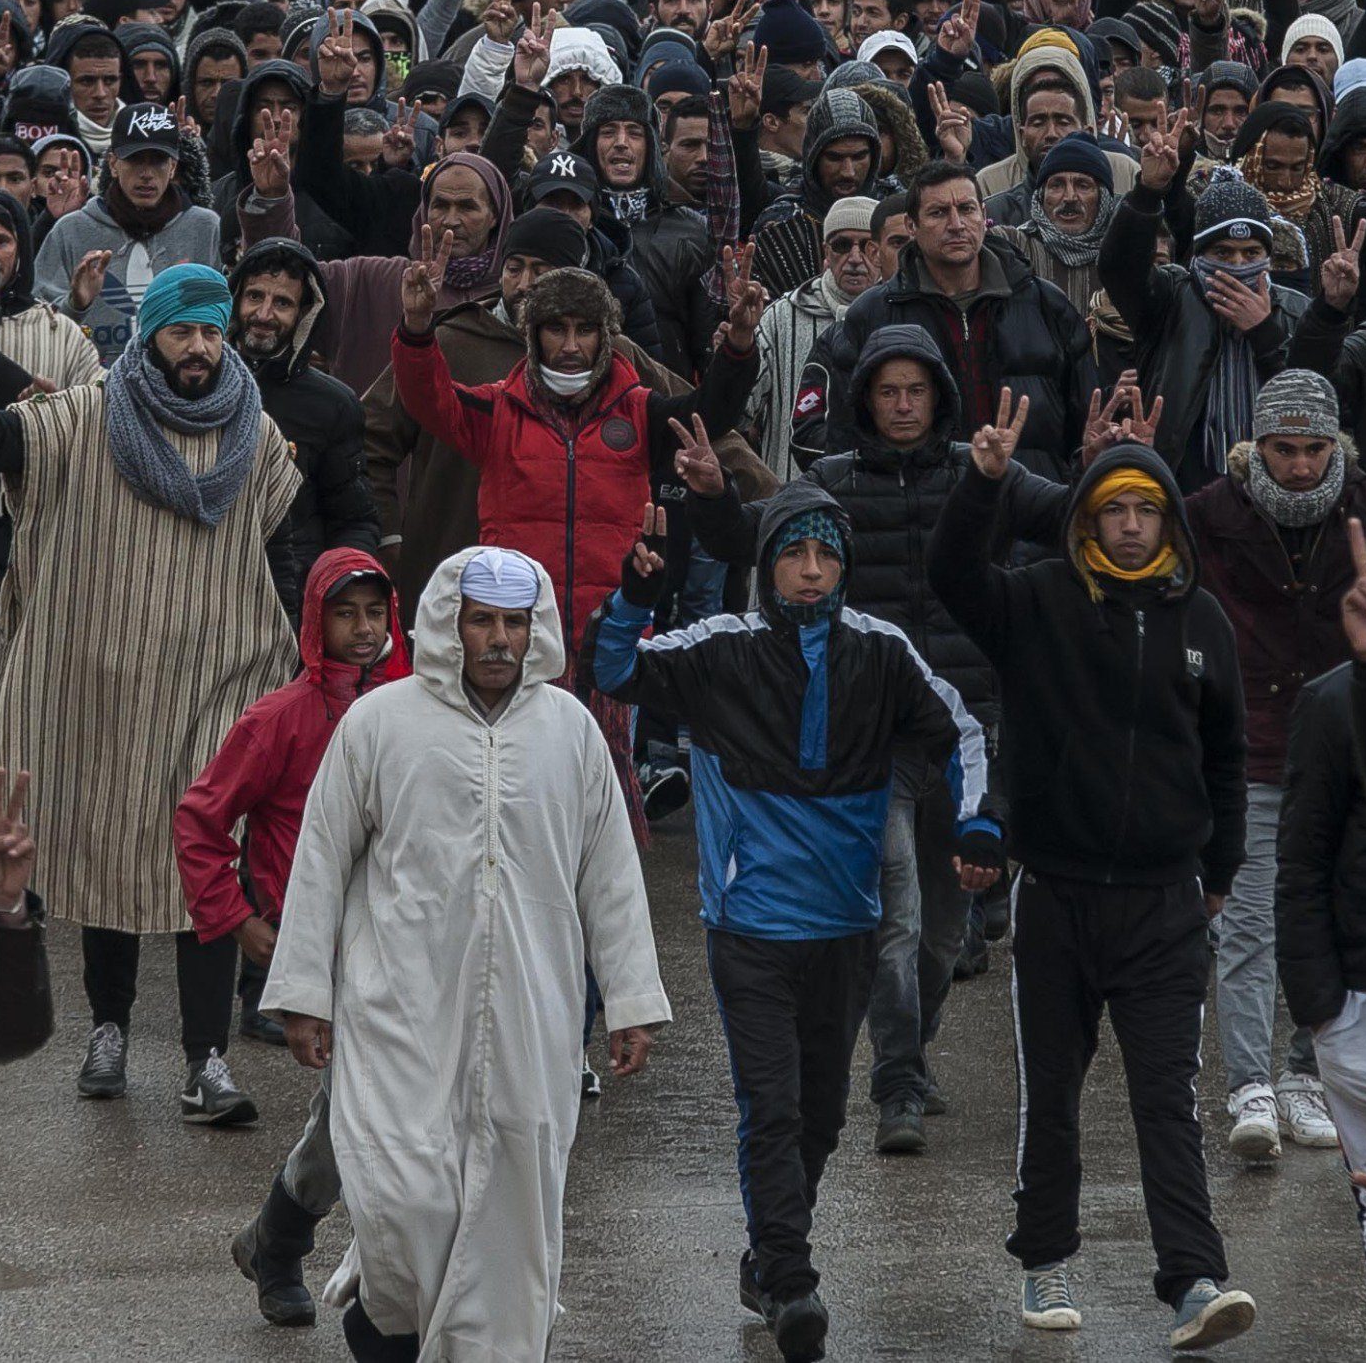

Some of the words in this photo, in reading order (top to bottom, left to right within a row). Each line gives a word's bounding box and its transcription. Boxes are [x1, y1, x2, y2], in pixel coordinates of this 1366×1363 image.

[127, 110, 176, 138] Kings
[549, 154, 577, 178] NY
[659, 483, 687, 500] EA7
